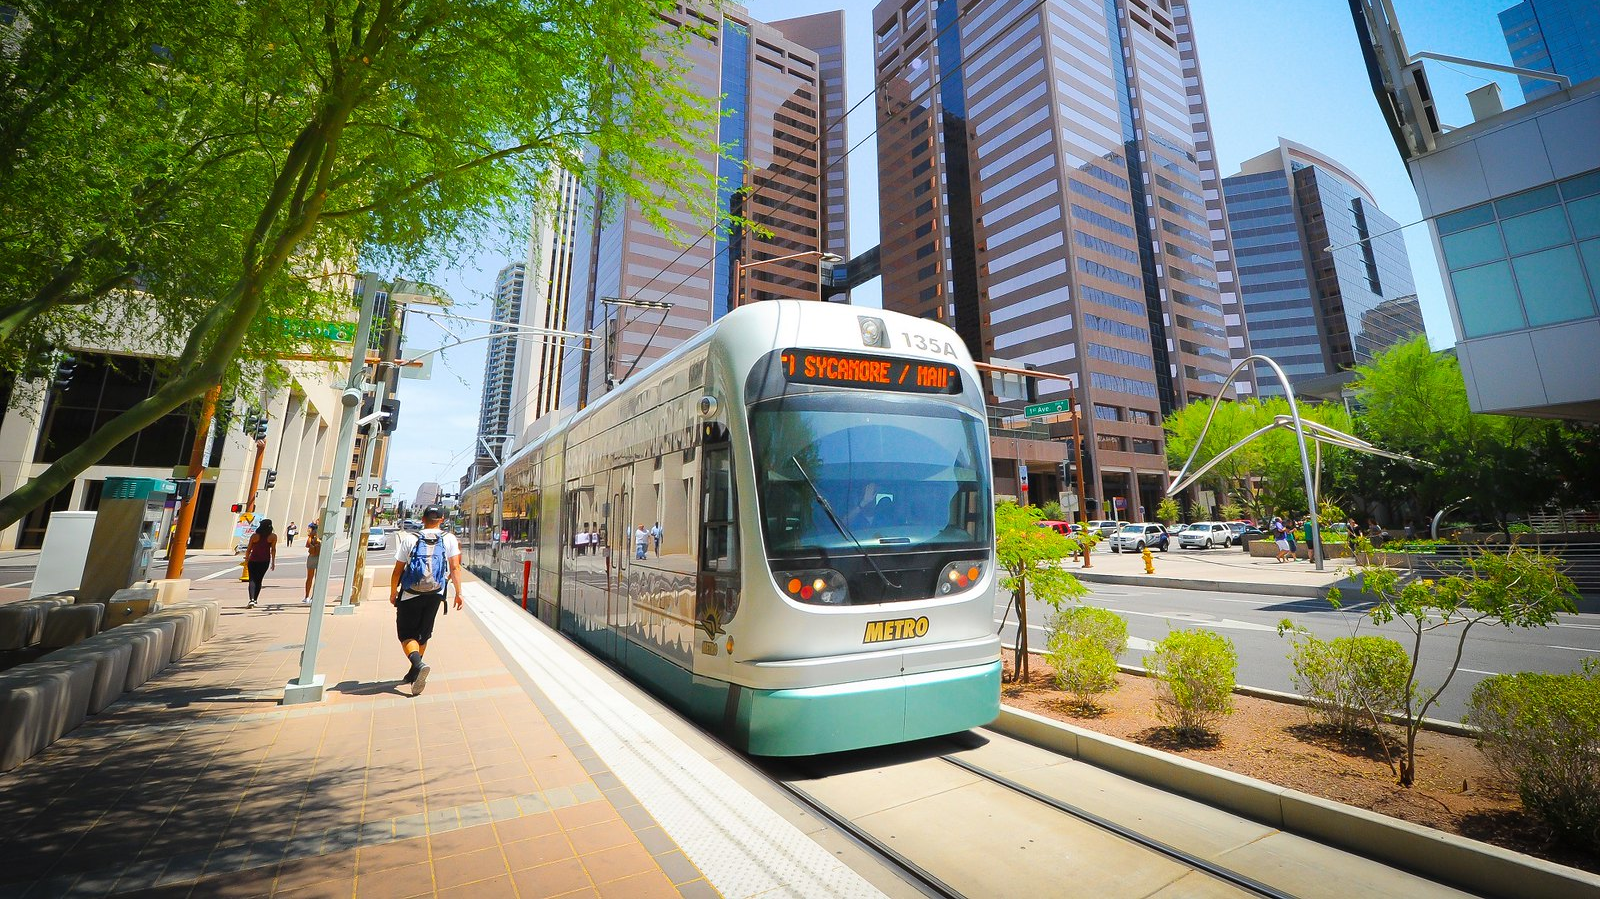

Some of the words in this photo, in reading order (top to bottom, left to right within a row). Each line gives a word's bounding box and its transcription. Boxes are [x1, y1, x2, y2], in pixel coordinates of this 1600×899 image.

[901, 332, 958, 360] 135A
[804, 355, 891, 384] SYCAMORE
[898, 364, 910, 384] /
[863, 616, 929, 644] METRO
